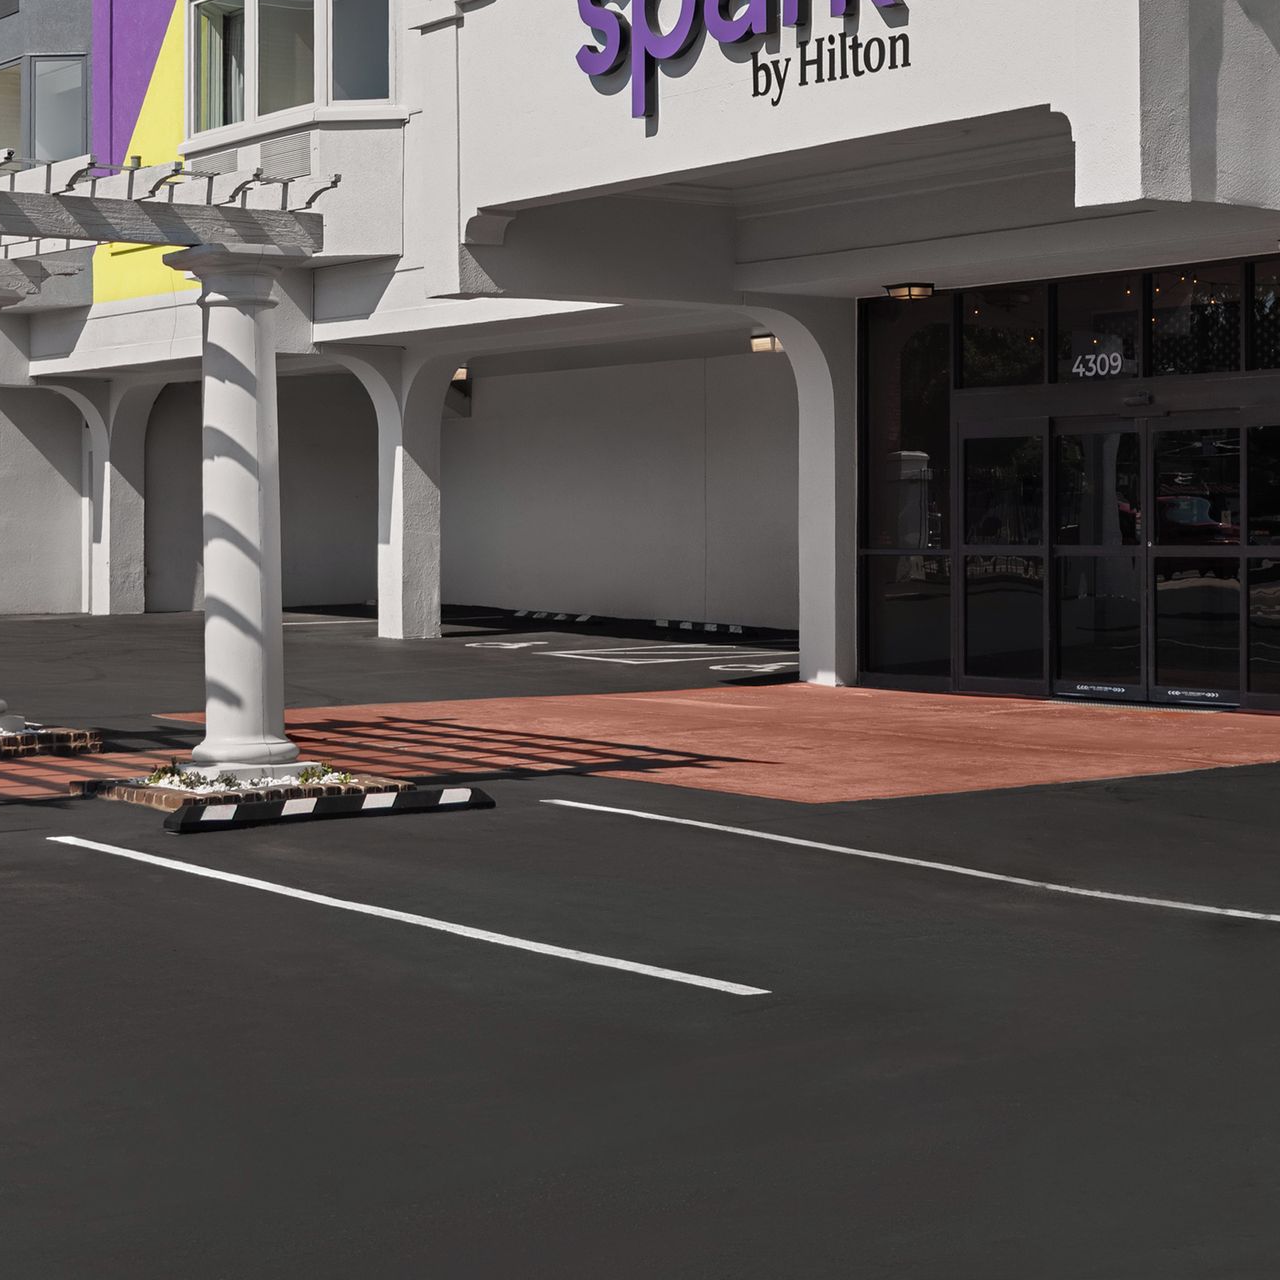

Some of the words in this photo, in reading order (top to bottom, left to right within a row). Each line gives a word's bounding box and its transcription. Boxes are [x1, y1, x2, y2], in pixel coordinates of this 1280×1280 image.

[750, 51, 791, 106] by
[798, 32, 911, 86] Hilton
[1071, 352, 1122, 377] 4309
